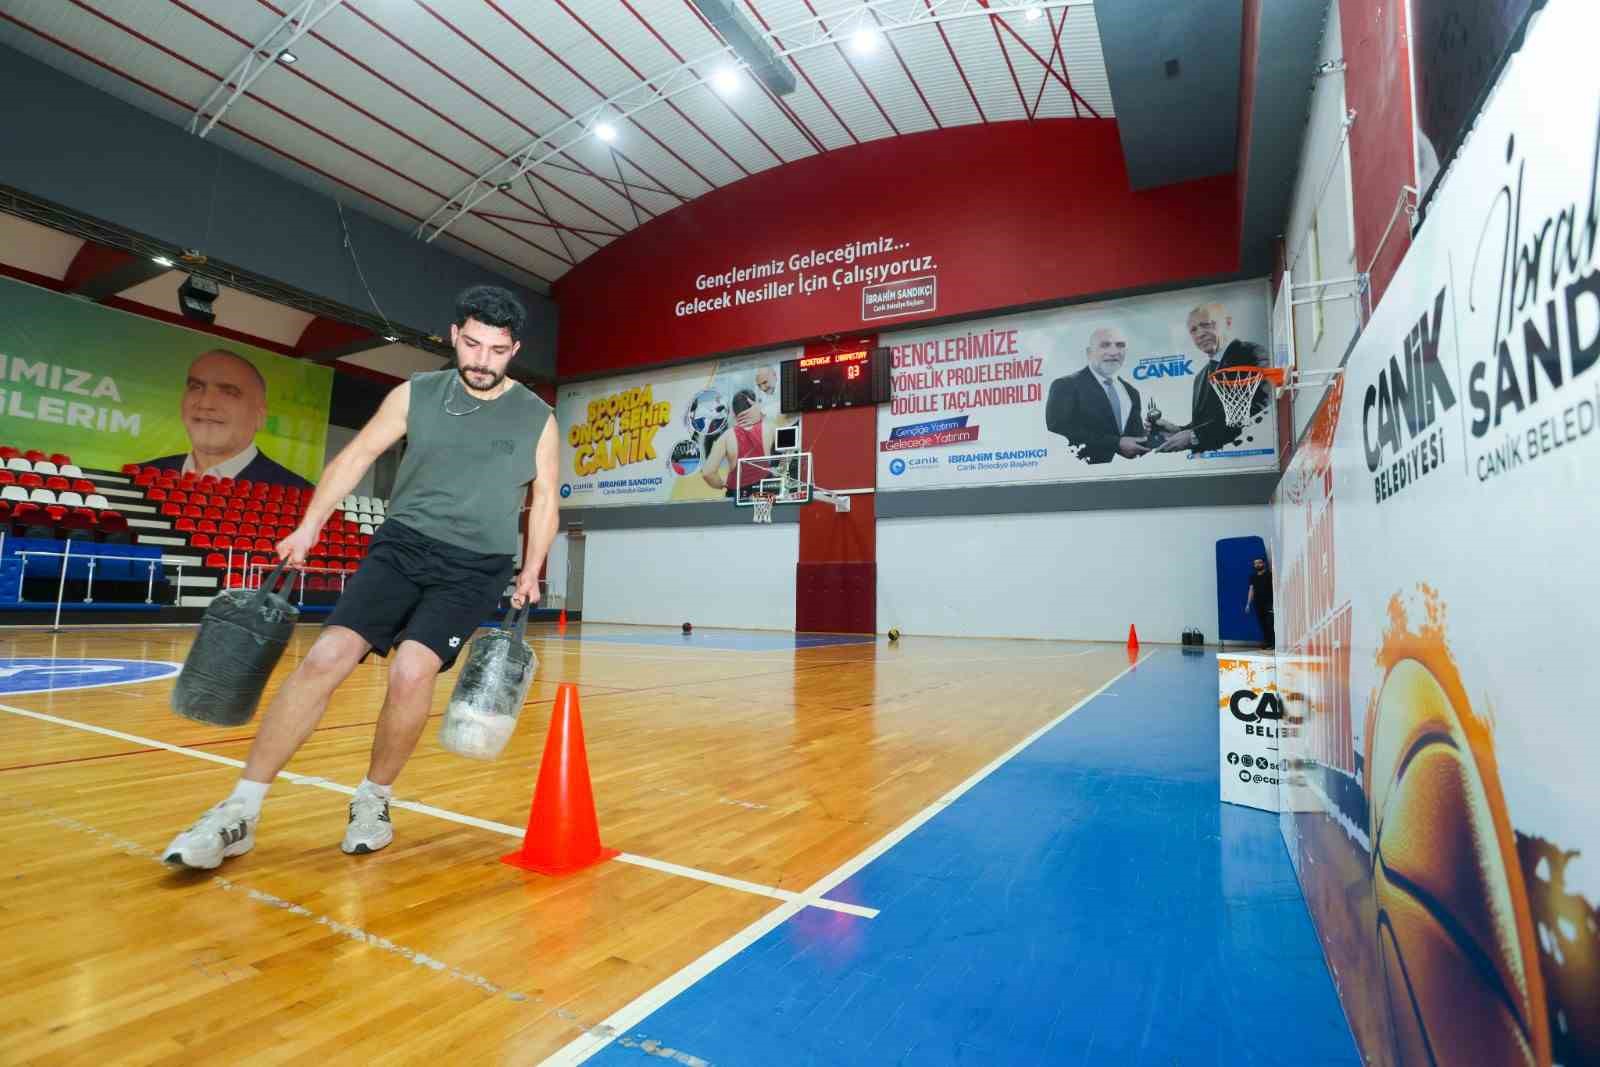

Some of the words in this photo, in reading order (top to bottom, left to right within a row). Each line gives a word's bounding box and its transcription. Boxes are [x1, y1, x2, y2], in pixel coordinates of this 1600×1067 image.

[675, 291, 731, 317] Gelecek
[735, 281, 794, 306] Nesiller
[799, 272, 828, 296] İçin
[832, 255, 938, 291] Çalışıyoruz.
[696, 260, 785, 289] Gençlerimiz
[789, 236, 910, 271] Geleceğimiz...
[890, 328, 1019, 368] GENÇLERİMİZE
[891, 368, 944, 393] YÖNELİK
[947, 355, 1044, 386] PROJELERİMİZ
[1362, 284, 1457, 473] CANİK
[890, 393, 939, 416] ÖDÜLLE
[943, 383, 1042, 413] TAÇLANDIRILDI
[574, 427, 657, 478] CANİK
[909, 455, 939, 466] canik
[1374, 427, 1446, 504] BELEDİYESİ
[1476, 432, 1523, 482] CANİK
